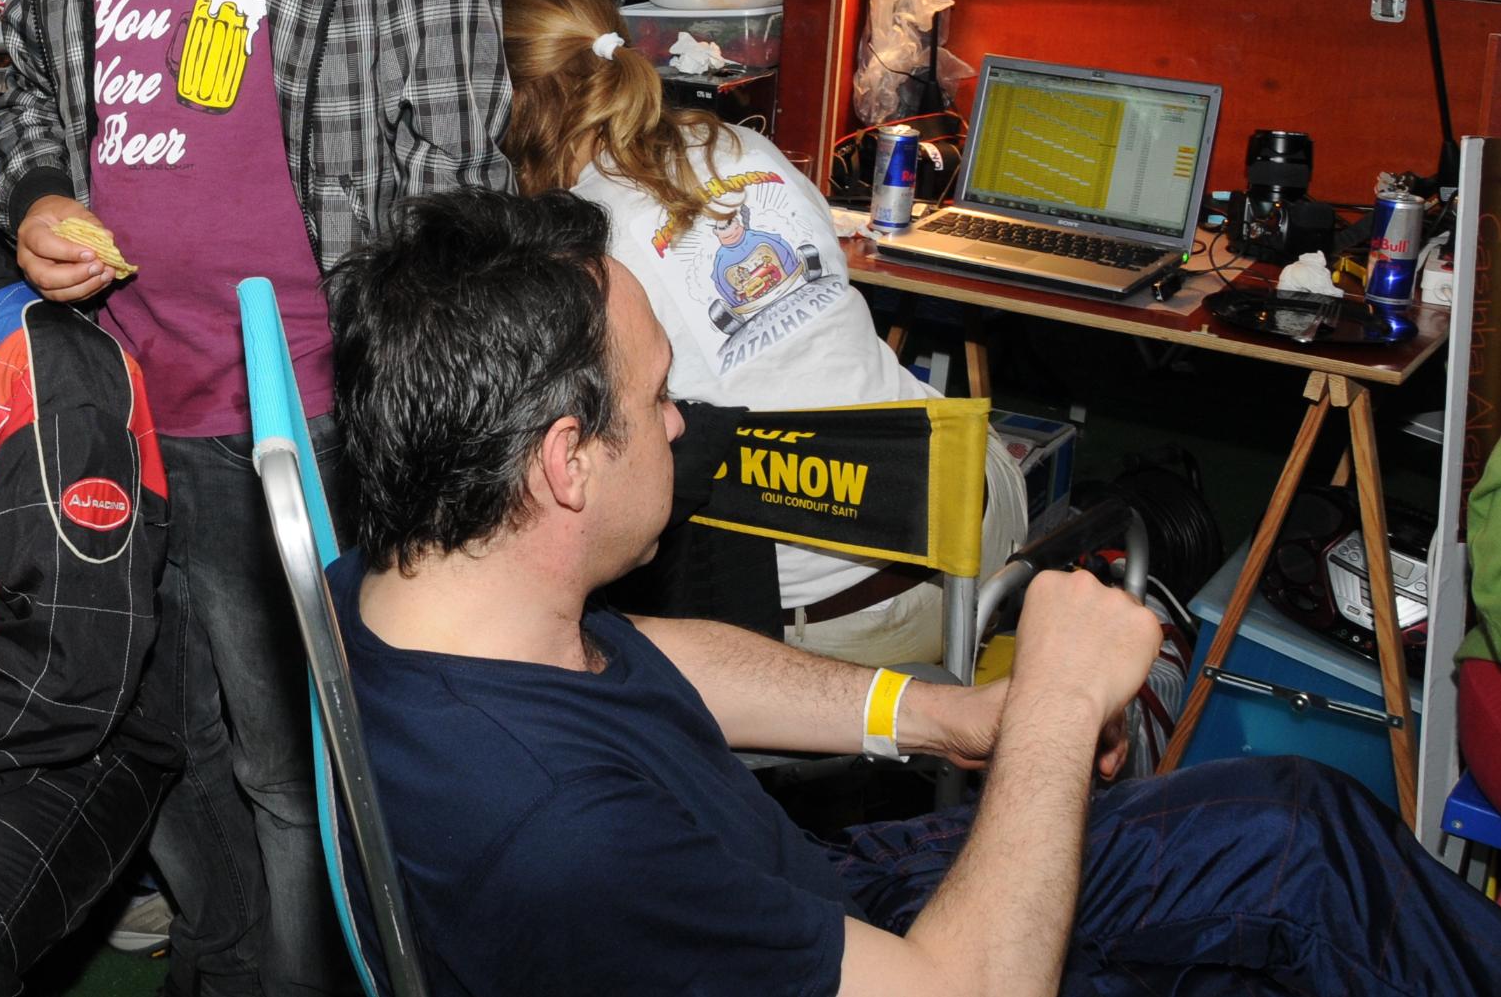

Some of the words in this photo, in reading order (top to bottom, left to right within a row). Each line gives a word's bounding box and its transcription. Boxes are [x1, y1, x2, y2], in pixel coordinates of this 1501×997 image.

[98, 111, 187, 166] Beer
[1380, 238, 1408, 253] Bull
[718, 308, 813, 376] BATALHA
[808, 280, 846, 311] 2012
[739, 446, 869, 506] KNOW
[68, 493, 92, 508] AJ
[760, 491, 783, 505] (QUI
[784, 494, 830, 514] CONDUIT
[831, 503, 859, 520] SAIT)
